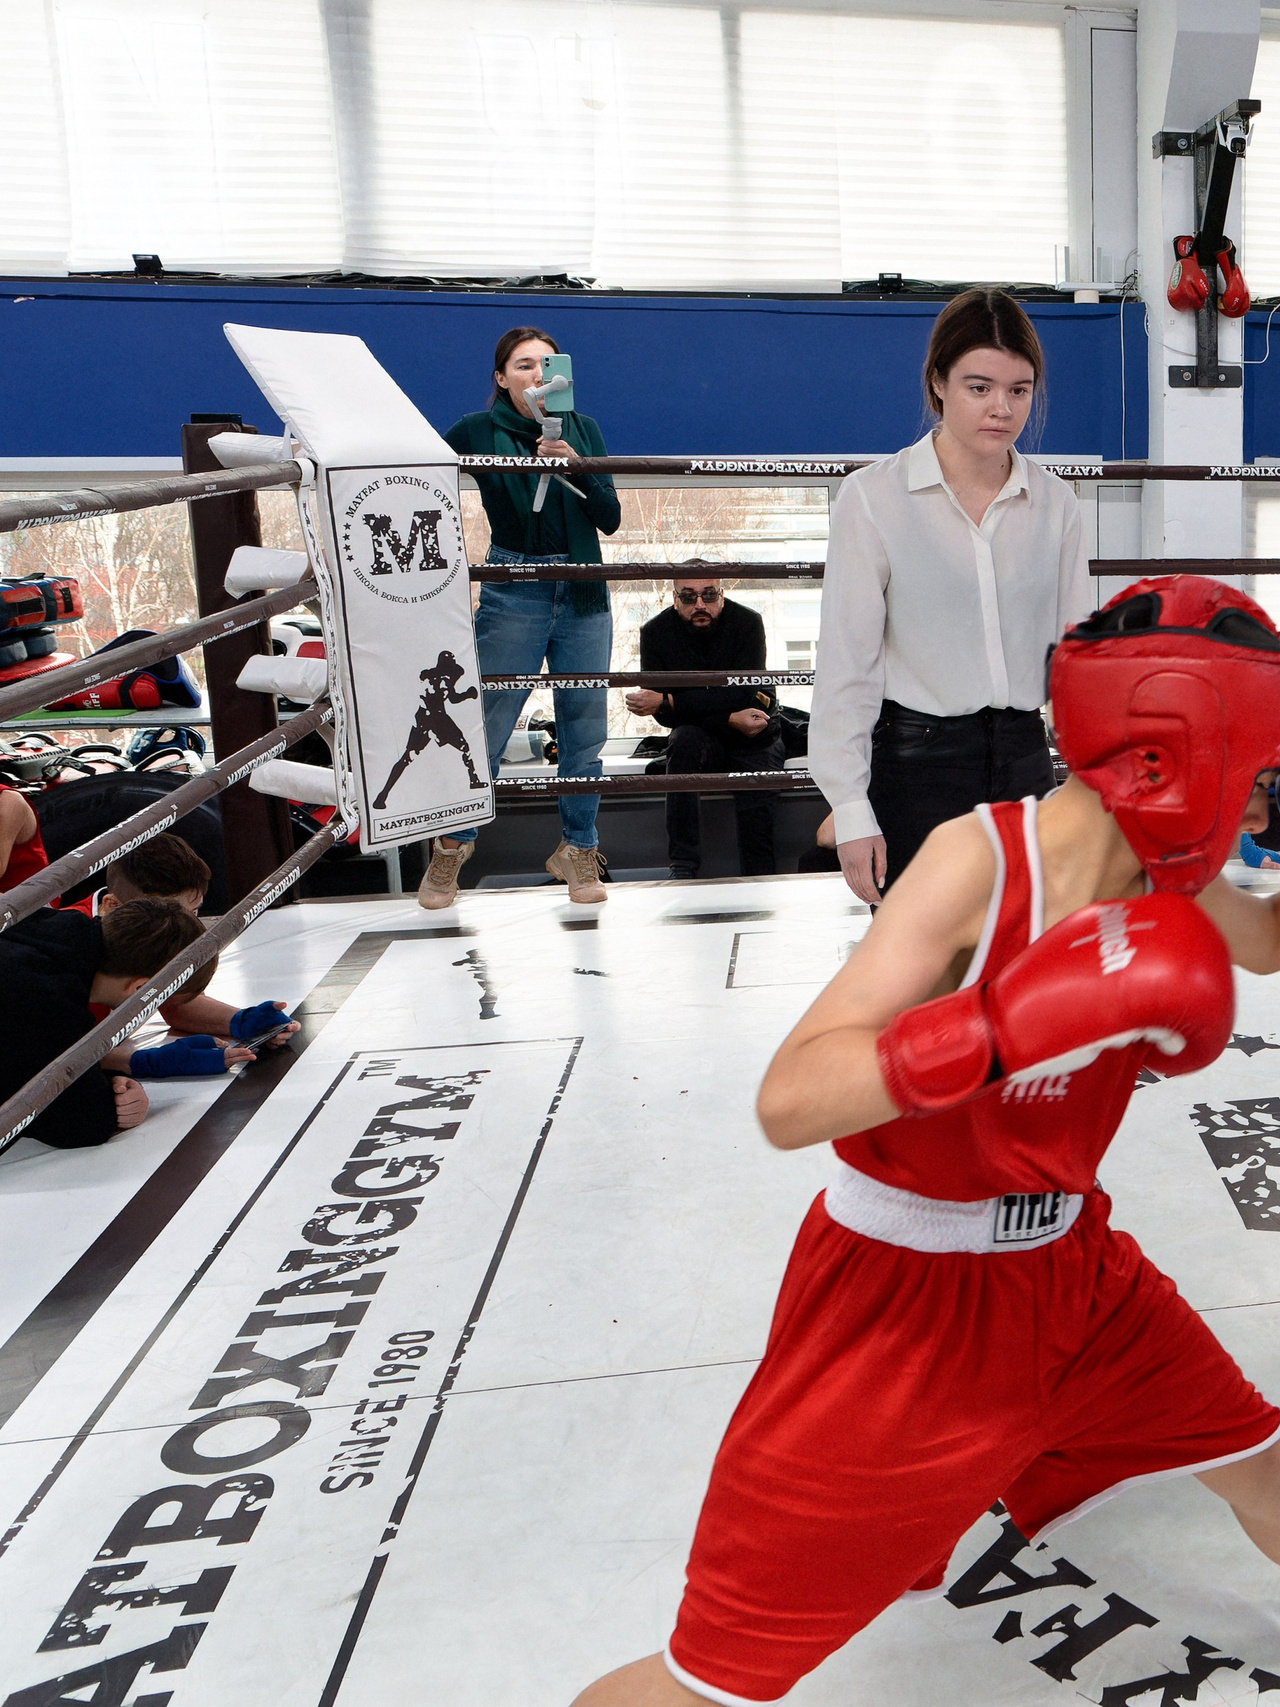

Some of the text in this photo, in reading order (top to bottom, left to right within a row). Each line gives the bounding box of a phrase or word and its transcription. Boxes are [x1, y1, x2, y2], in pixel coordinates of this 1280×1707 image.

[690, 460, 846, 474] MAYFATBOXINGGYM
[345, 475, 454, 518] MAYFAT BOXING GYM
[362, 509, 449, 576] M
[353, 557, 462, 605] ШКОЛА БОКСА И КИКБОКСИНГА
[379, 801, 486, 832] MAYFATBOXINGGYM
[1002, 1191, 1062, 1232] TITLE
[0, 1069, 491, 1707] ATBOXINGGYM
[320, 1329, 435, 1495] SINCE 1980
